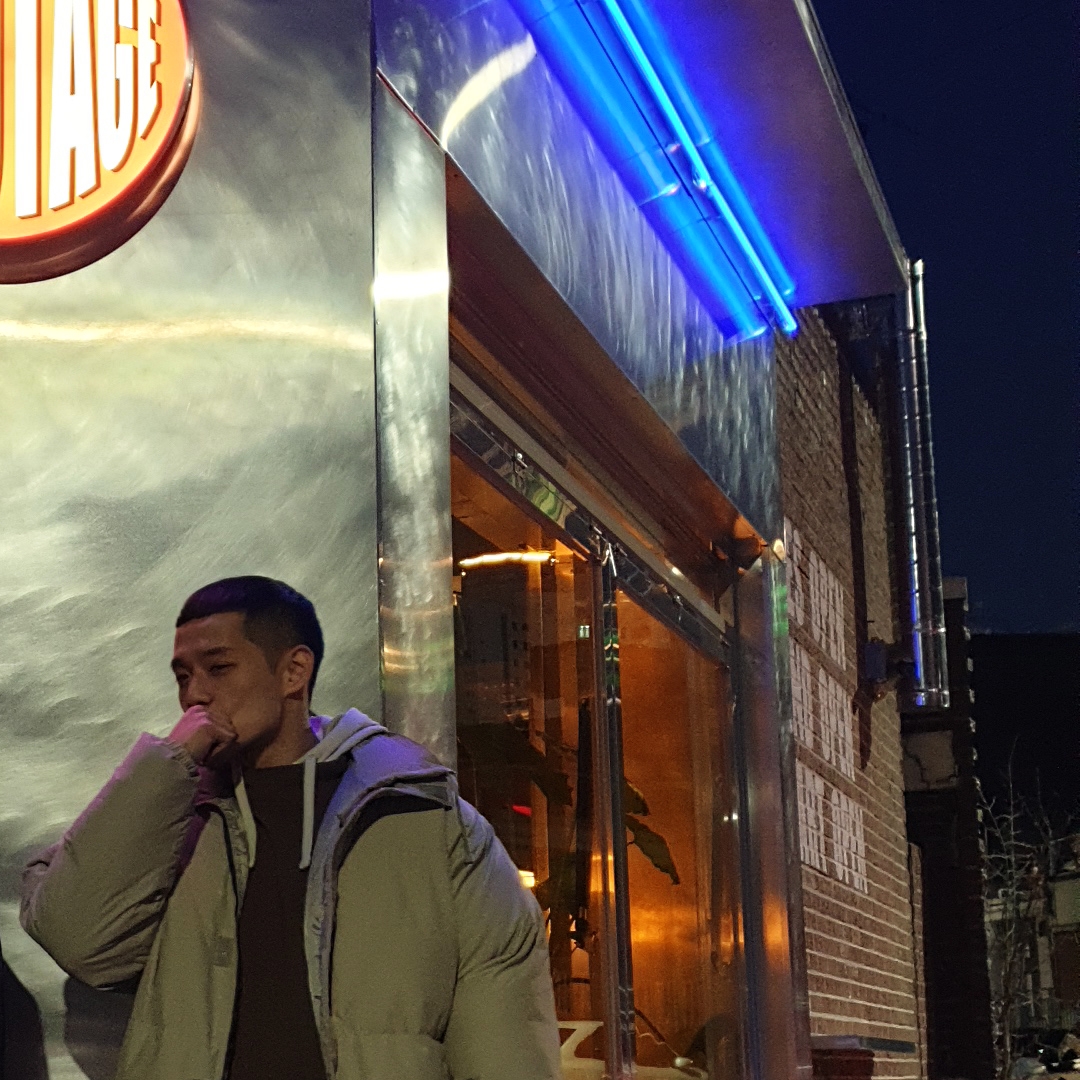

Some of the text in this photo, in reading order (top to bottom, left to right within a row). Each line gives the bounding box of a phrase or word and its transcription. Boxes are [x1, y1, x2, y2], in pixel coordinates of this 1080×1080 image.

[809, 550, 847, 672] OPEN
[819, 667, 856, 783] OPEN
[832, 788, 869, 895] OPEN
